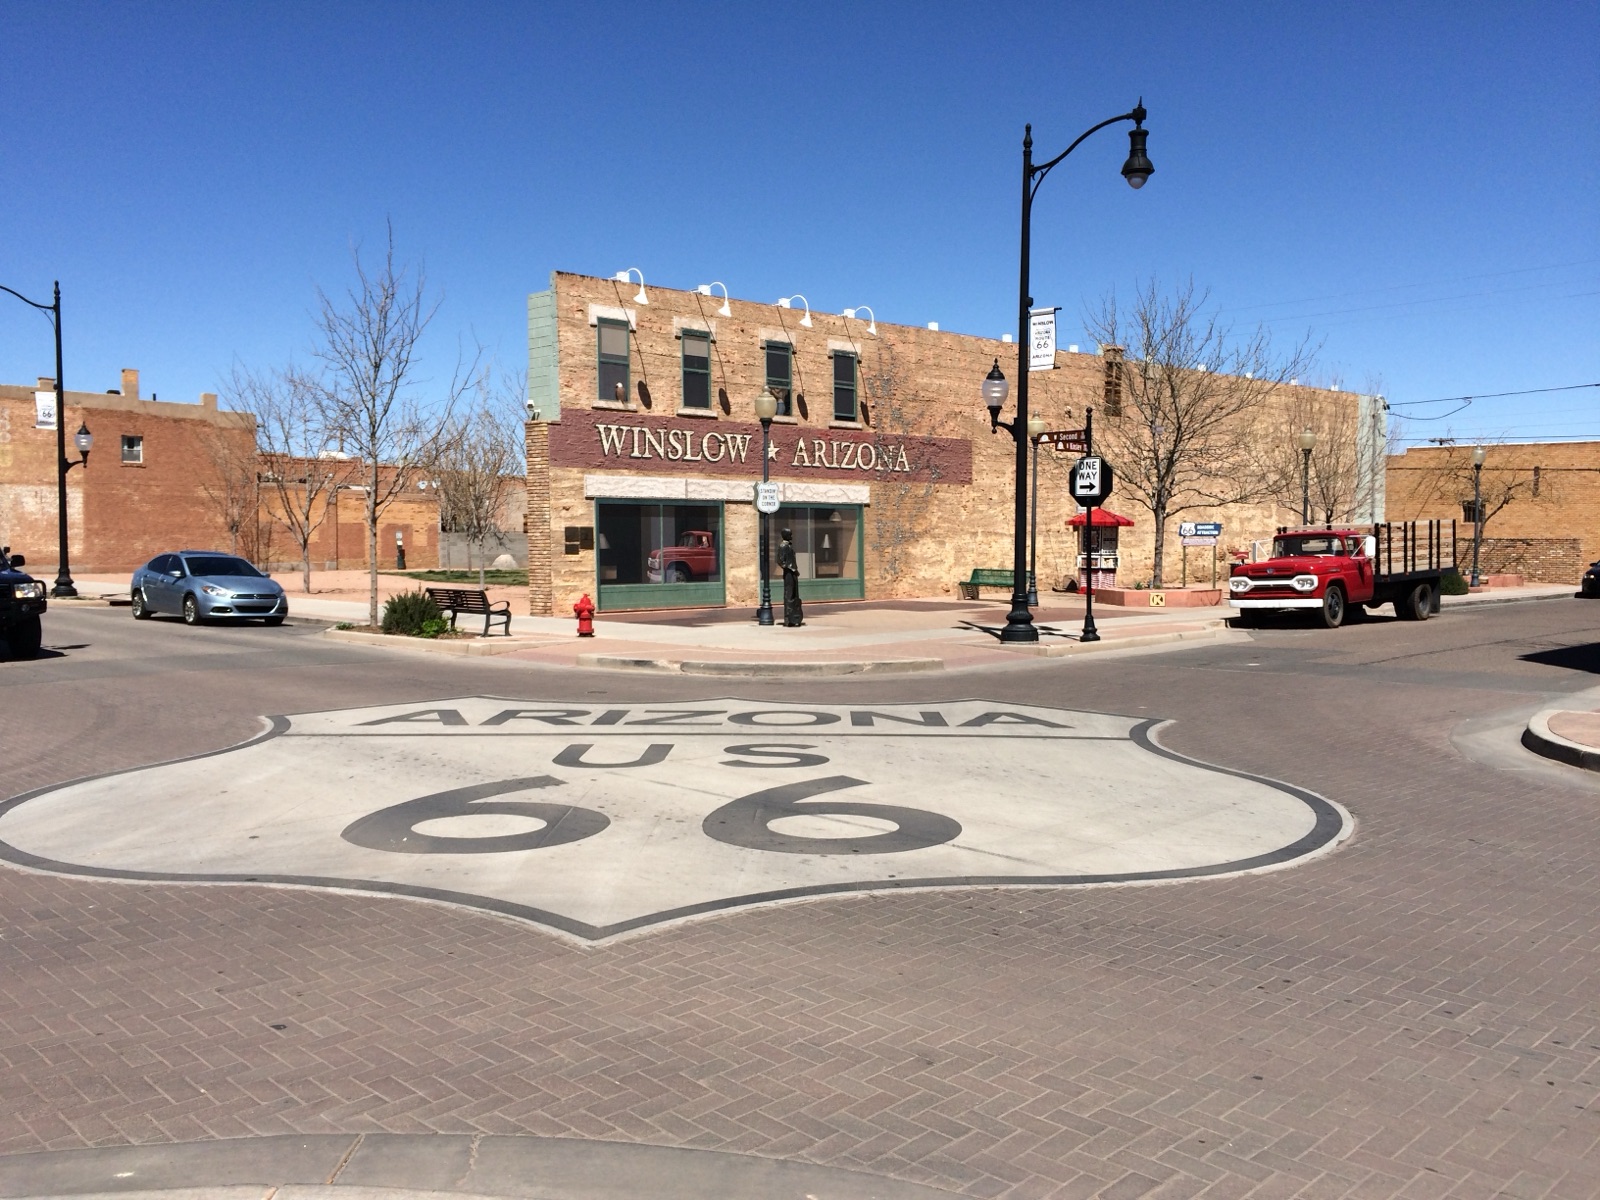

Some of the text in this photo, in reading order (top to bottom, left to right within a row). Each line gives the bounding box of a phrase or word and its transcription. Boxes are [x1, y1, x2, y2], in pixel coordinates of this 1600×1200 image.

[1036, 340, 1049, 349] 66
[42, 410, 53, 418] 66
[1059, 432, 1078, 441] Second
[595, 423, 911, 472] WINSLOW ARIZONA
[1078, 461, 1097, 471] ONE
[1079, 471, 1097, 480] WAY
[1182, 526, 1194, 535] 66
[349, 708, 1078, 730] ARIZONA
[340, 774, 963, 855] 66
